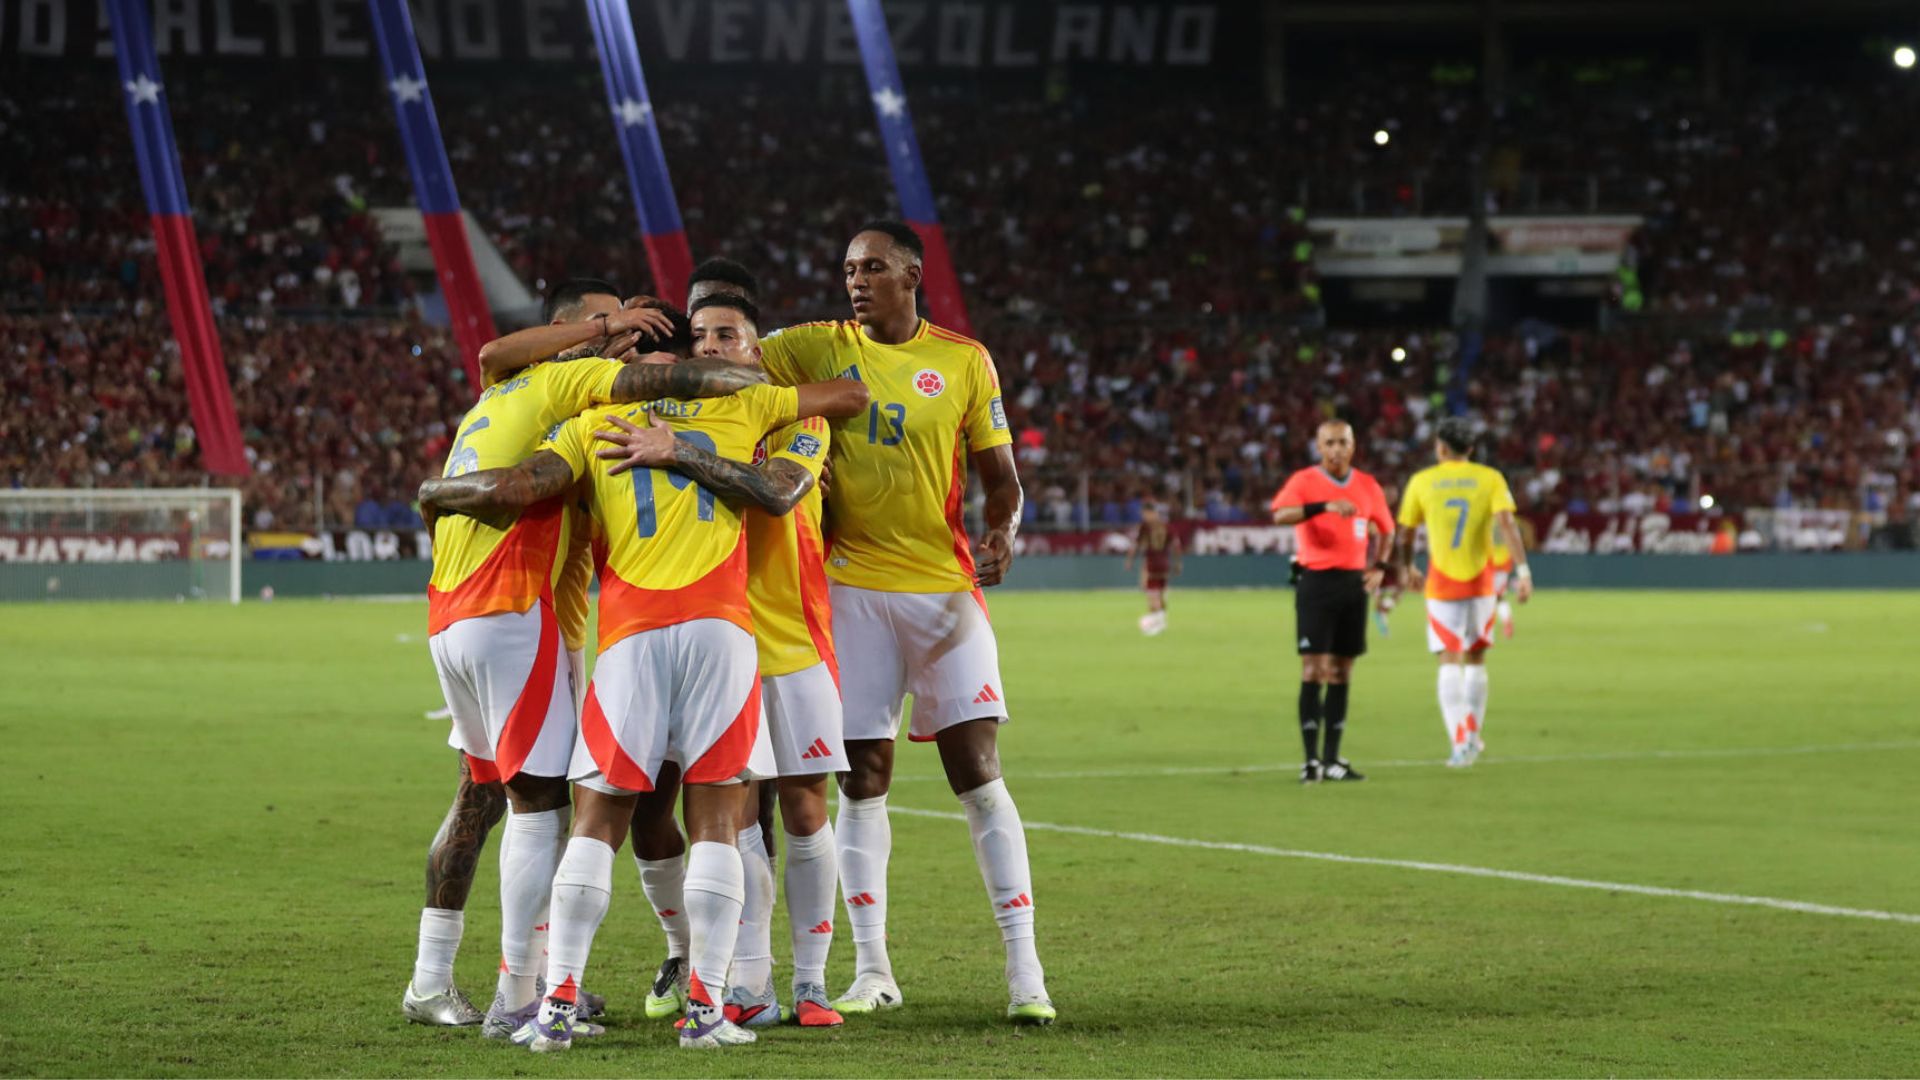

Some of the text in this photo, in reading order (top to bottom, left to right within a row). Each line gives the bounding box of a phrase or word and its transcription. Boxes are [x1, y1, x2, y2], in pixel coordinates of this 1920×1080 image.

[655, 2, 1219, 66] VENEZOLANO
[446, 416, 490, 478] 6
[868, 400, 906, 446] 13
[630, 430, 717, 539] 19
[1445, 497, 1469, 549] 7
